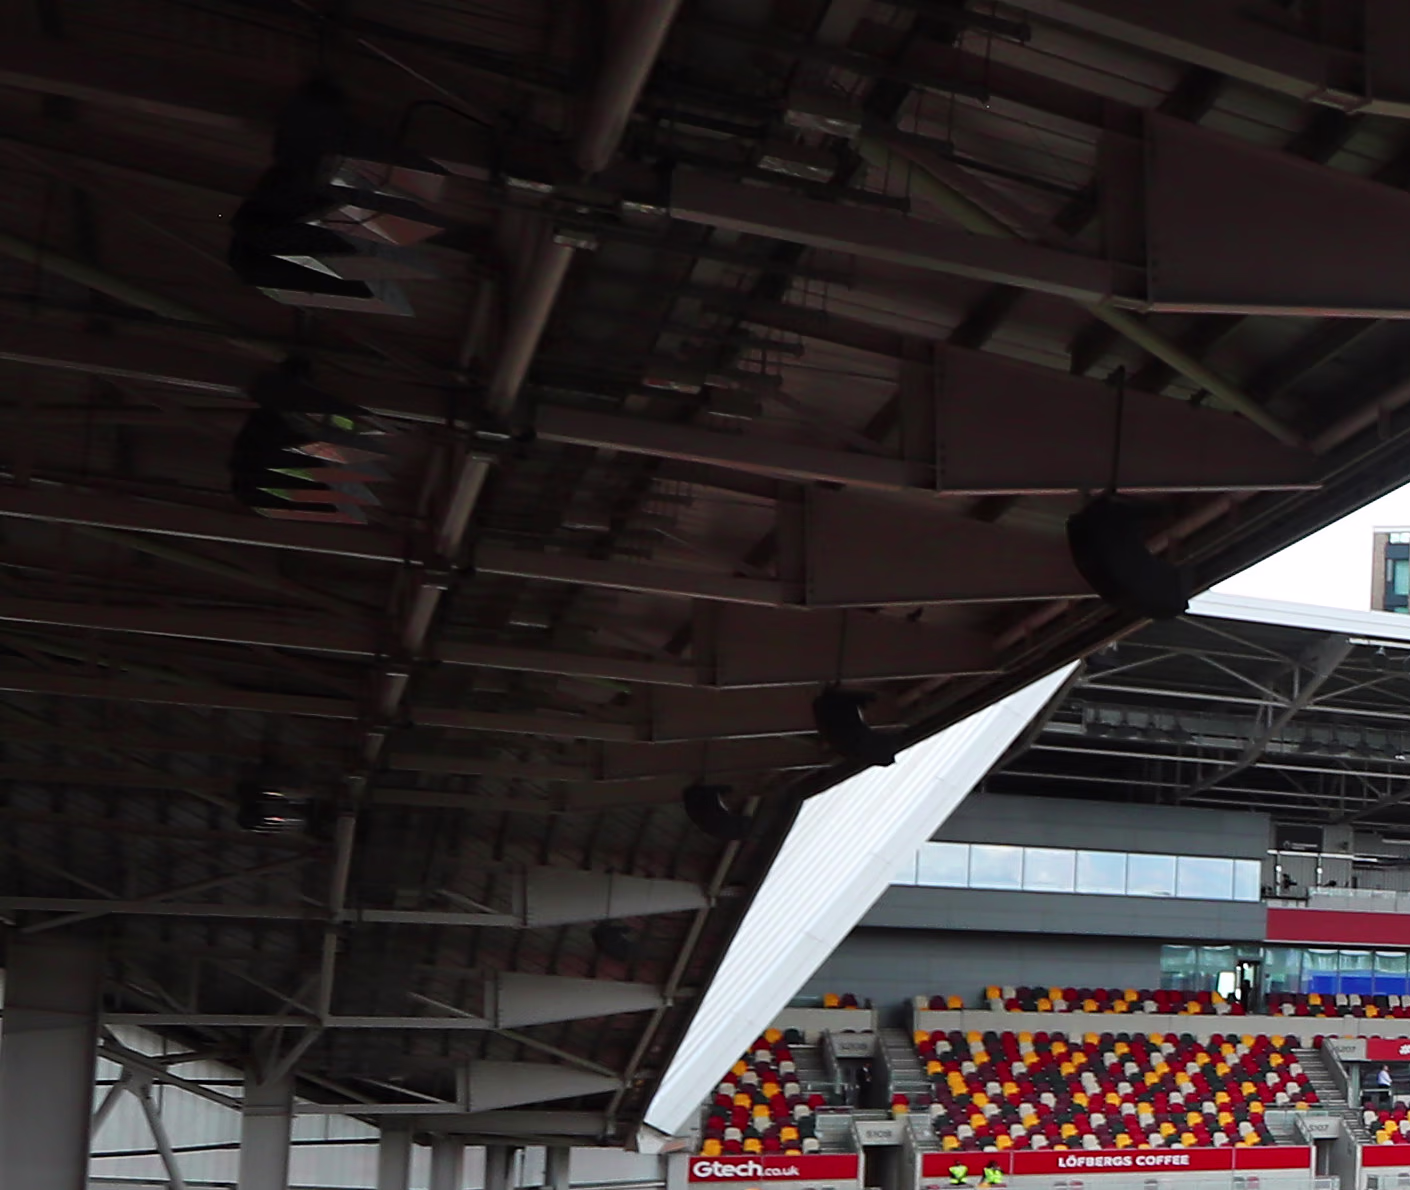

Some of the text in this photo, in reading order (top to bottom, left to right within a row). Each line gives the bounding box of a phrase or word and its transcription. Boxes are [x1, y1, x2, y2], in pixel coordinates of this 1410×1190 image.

[1058, 1153, 1190, 1167] LÖFBERGS COFFEE
[693, 1160, 799, 1177] Gtech.co.uk
